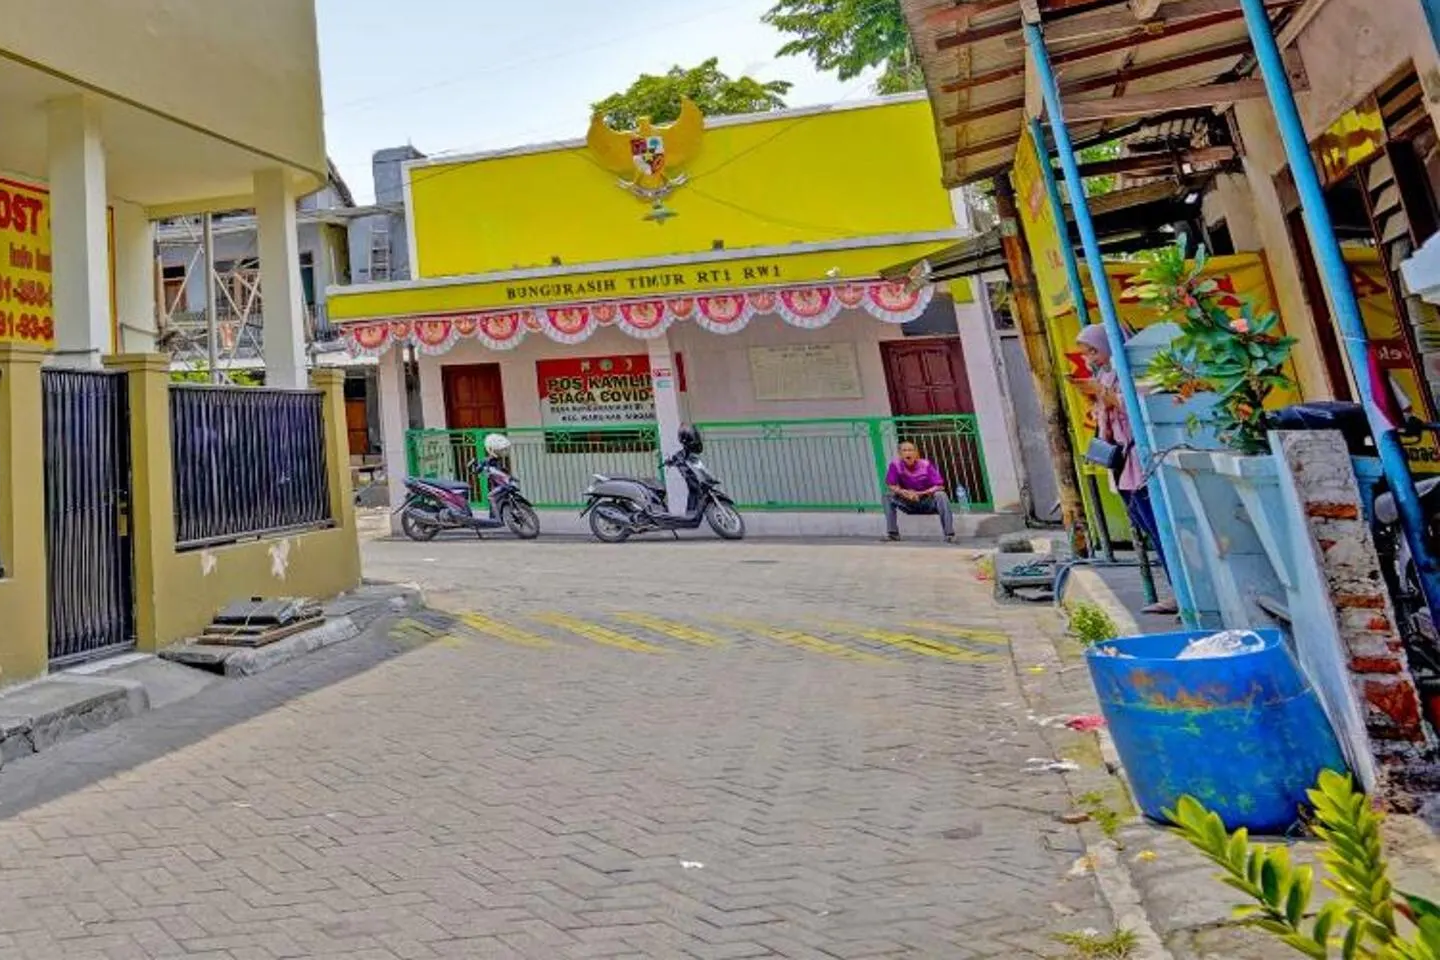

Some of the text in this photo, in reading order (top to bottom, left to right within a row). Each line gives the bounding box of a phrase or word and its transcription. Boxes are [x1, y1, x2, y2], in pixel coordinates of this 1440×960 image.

[506, 264, 781, 300] BUNGURASIH TIMUR RT1 RW1
[548, 377, 582, 391] POS
[549, 391, 596, 405] SIAGA
